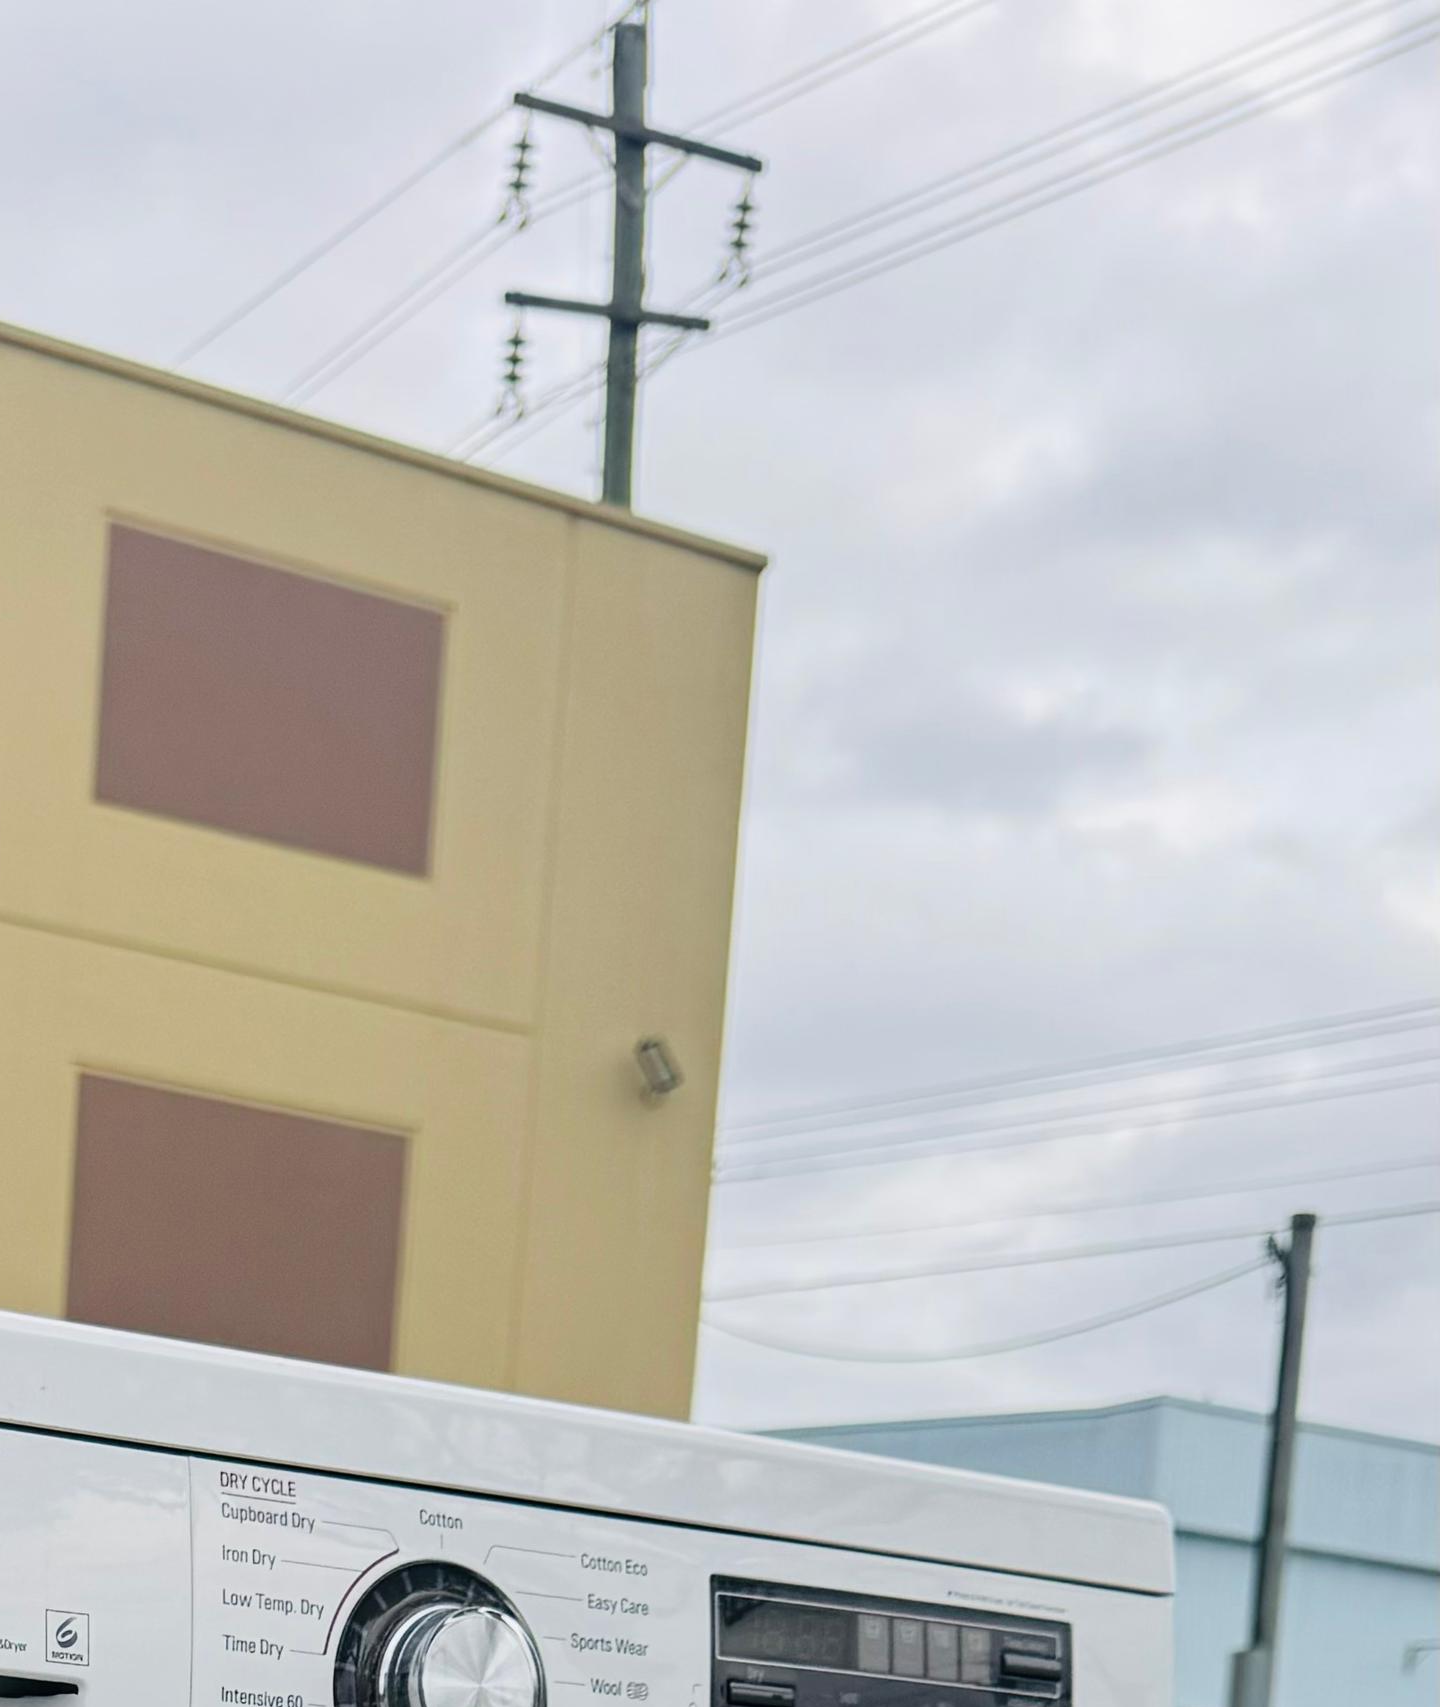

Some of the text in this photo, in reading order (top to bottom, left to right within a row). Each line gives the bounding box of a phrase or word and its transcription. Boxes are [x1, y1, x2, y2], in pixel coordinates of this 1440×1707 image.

[220, 1471, 296, 1498] DRY CYCLE
[221, 1502, 315, 1533] Cupboard Dry
[419, 1510, 462, 1530] Cotton
[221, 1545, 276, 1570] Iron Dry
[581, 1553, 648, 1577] Cotton Eco
[222, 1590, 324, 1620] Low Temp. Dry
[587, 1594, 648, 1616] Easy Care
[52, 1651, 84, 1661] MOTION
[222, 1635, 284, 1659] Time Dry
[571, 1634, 648, 1656] Sports Wear
[590, 1679, 621, 1696] Wool
